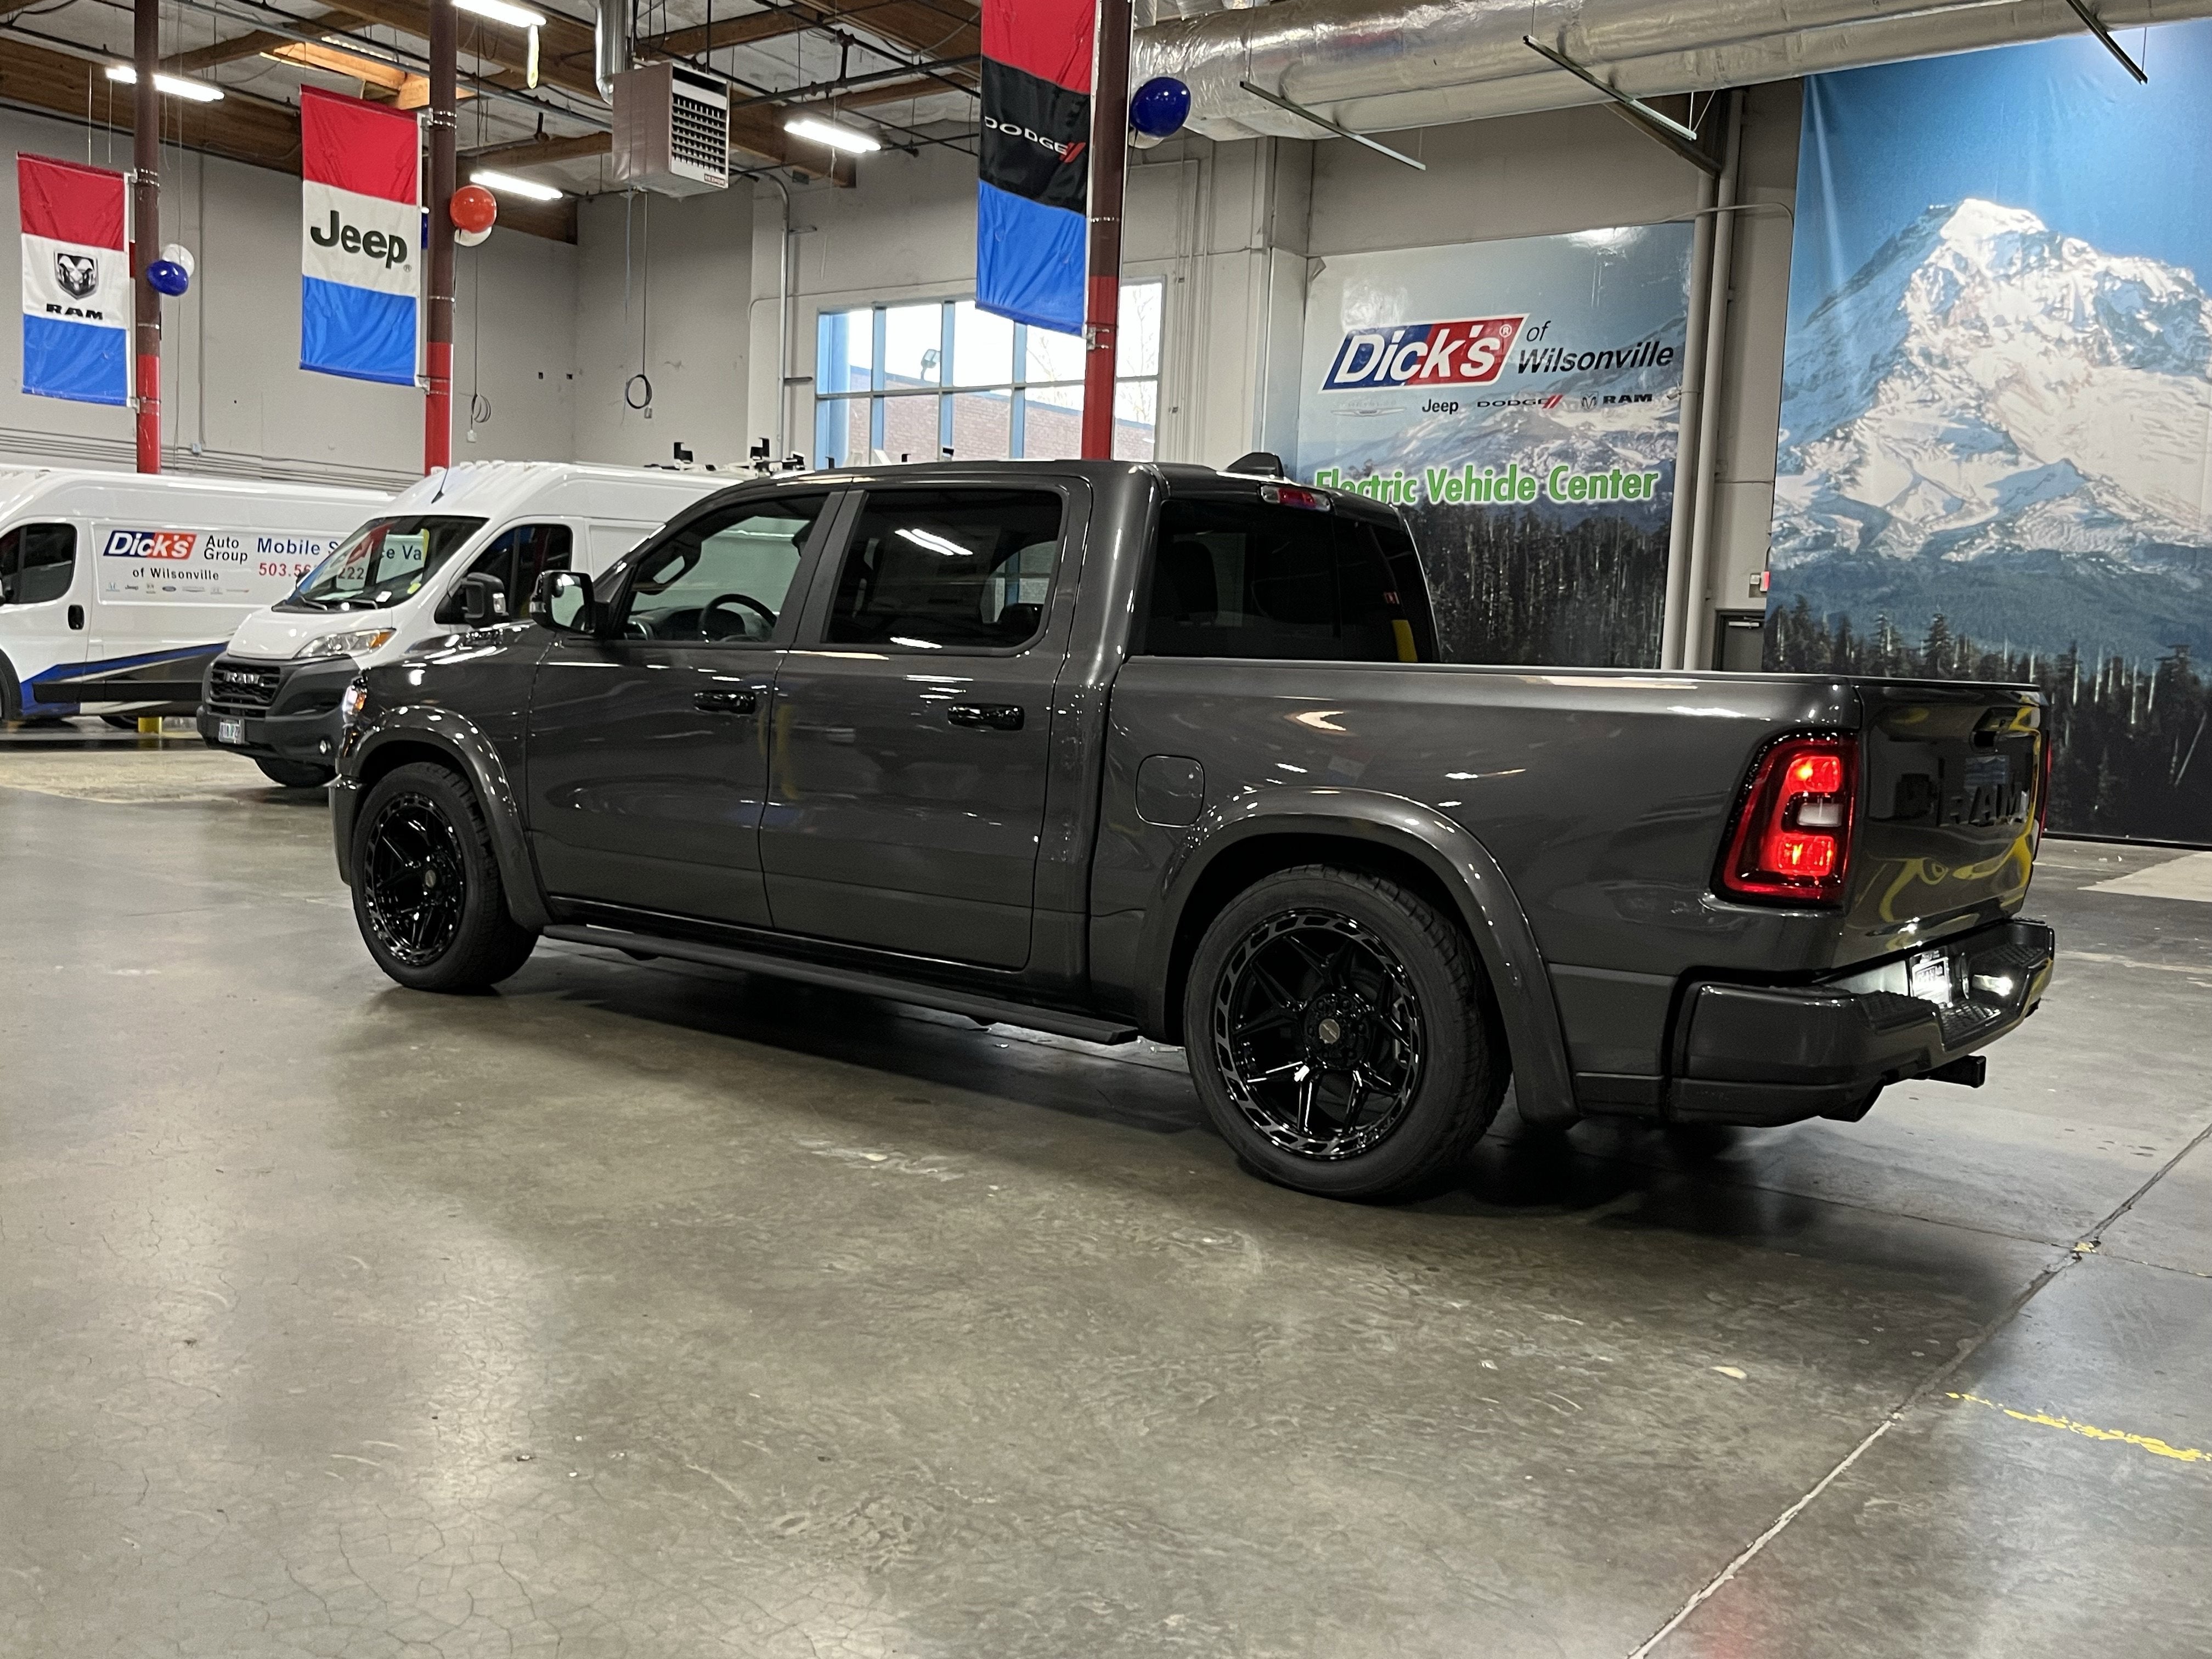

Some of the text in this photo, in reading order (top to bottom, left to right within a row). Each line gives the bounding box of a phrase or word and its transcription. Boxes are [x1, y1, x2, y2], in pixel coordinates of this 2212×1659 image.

[984, 116, 1068, 156] DODGE
[310, 210, 408, 269] Jeep
[46, 303, 103, 320] RAM
[1334, 320, 1551, 383] Dick's of
[1517, 341, 1674, 374] Wilsonville
[1422, 399, 1459, 415] Jeep
[1602, 393, 1652, 404] RAM
[1427, 464, 1536, 502] Vehicle
[1549, 465, 1658, 501] Center
[108, 532, 189, 558] Dick's
[206, 535, 239, 549] Auto
[257, 538, 320, 555] Mobile
[402, 545, 422, 561] Va
[204, 548, 248, 564] Group
[132, 567, 219, 580] of Wilsonville
